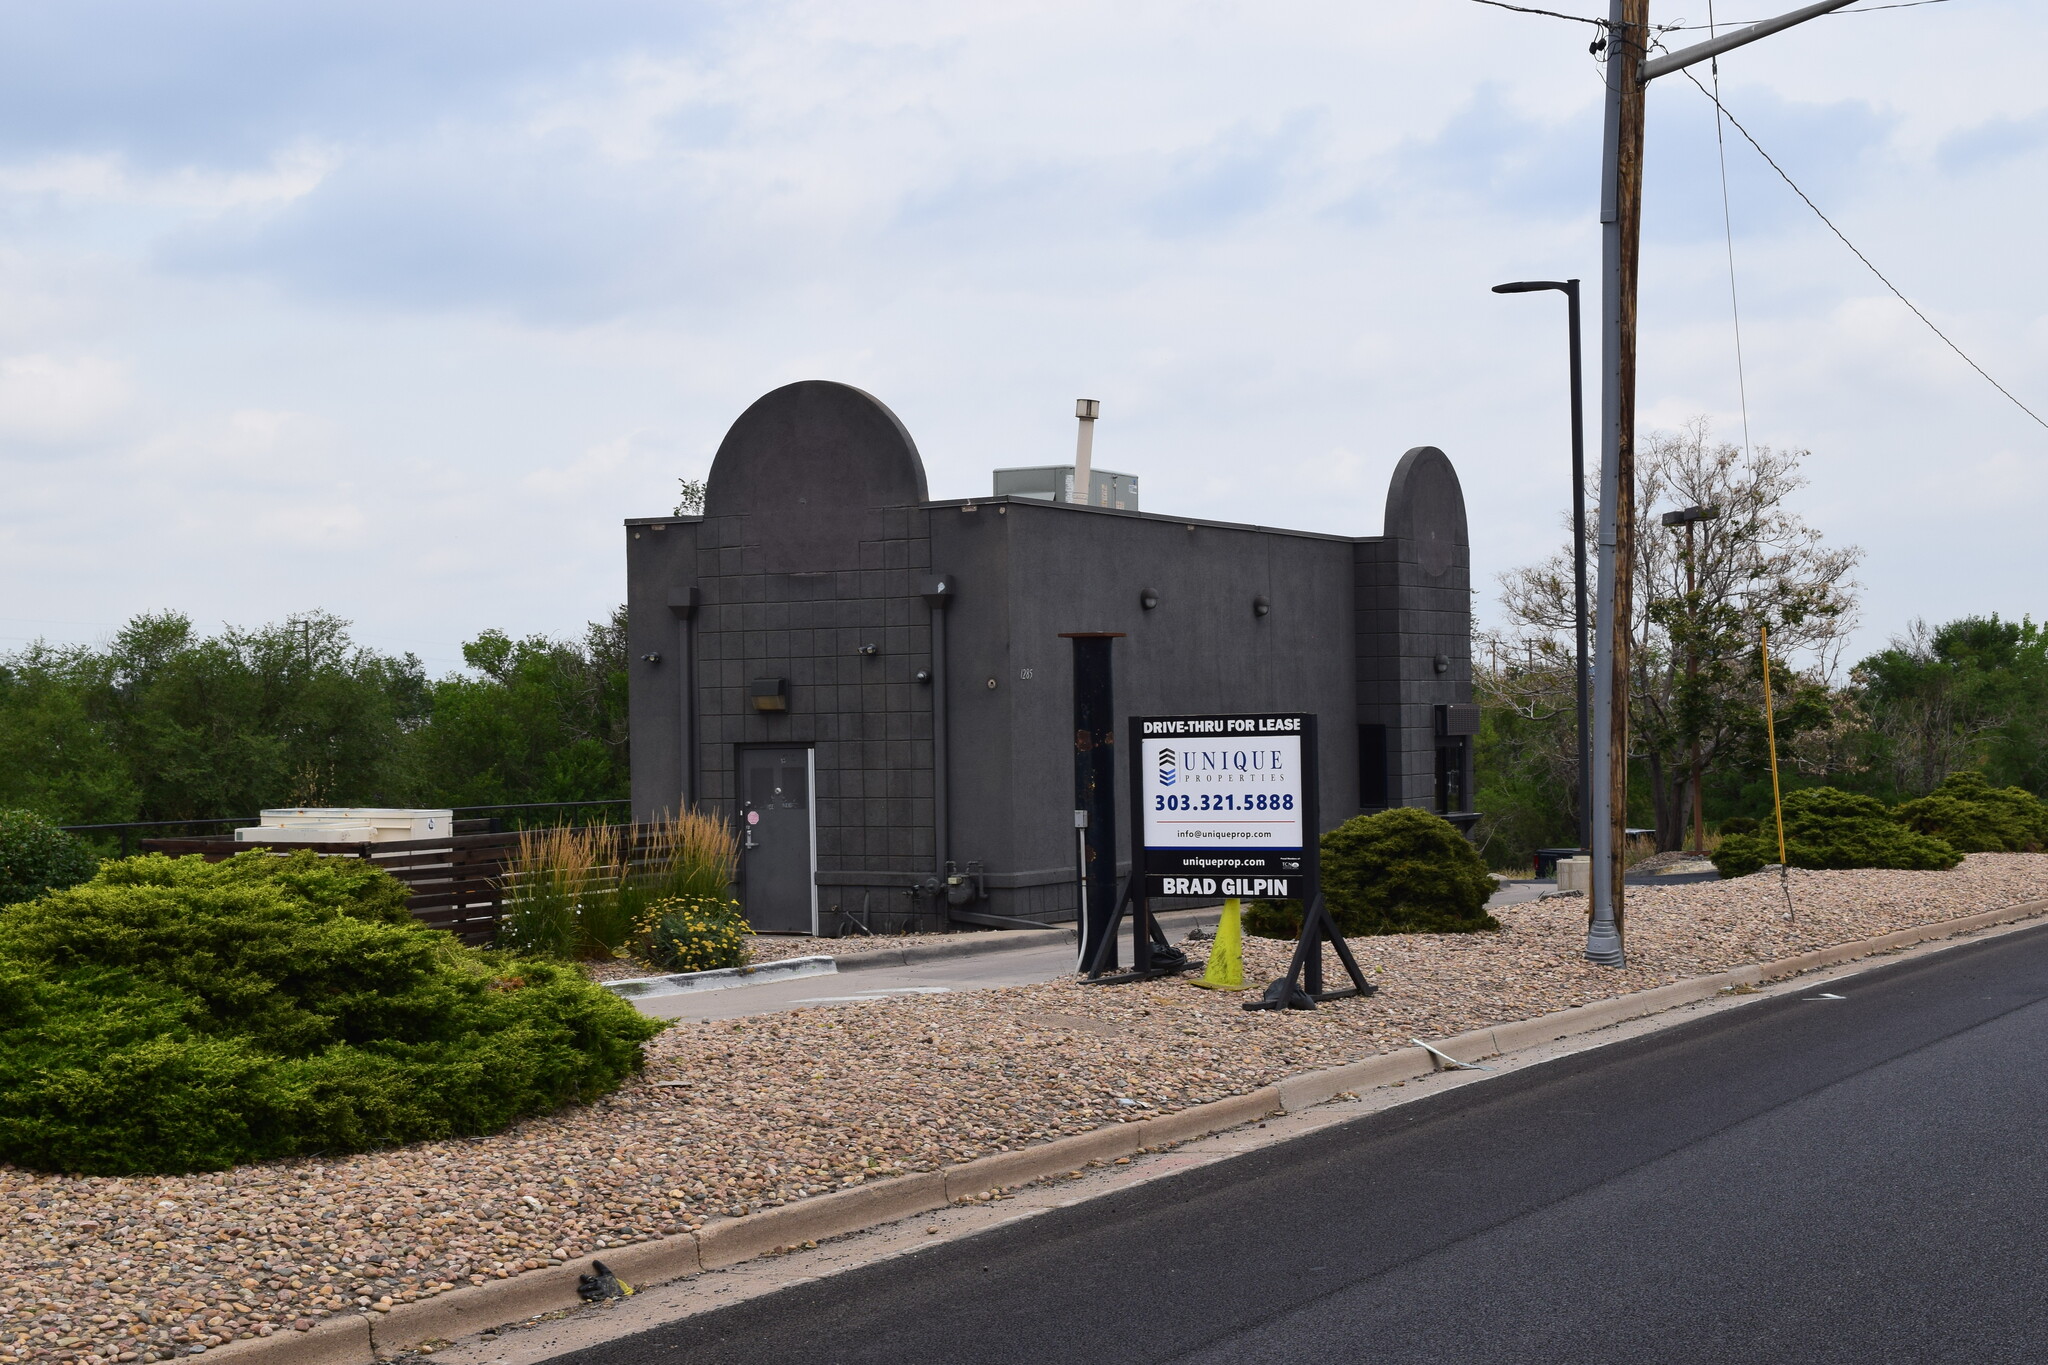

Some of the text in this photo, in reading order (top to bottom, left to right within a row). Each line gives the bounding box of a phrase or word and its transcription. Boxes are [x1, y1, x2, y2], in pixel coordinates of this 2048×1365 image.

[1020, 668, 1033, 680] 1285
[1143, 718, 1301, 734] DRIVE-THRU FOR LEASE
[1183, 750, 1283, 772] UNIQUE
[1185, 774, 1284, 782] PROPERTIES
[1155, 794, 1294, 811] 303.321.5888
[1177, 829, 1272, 839] info@uniqueprop.com
[1183, 857, 1265, 868] uniqueprop.com
[1163, 878, 1288, 896] BRAD GILPIN
